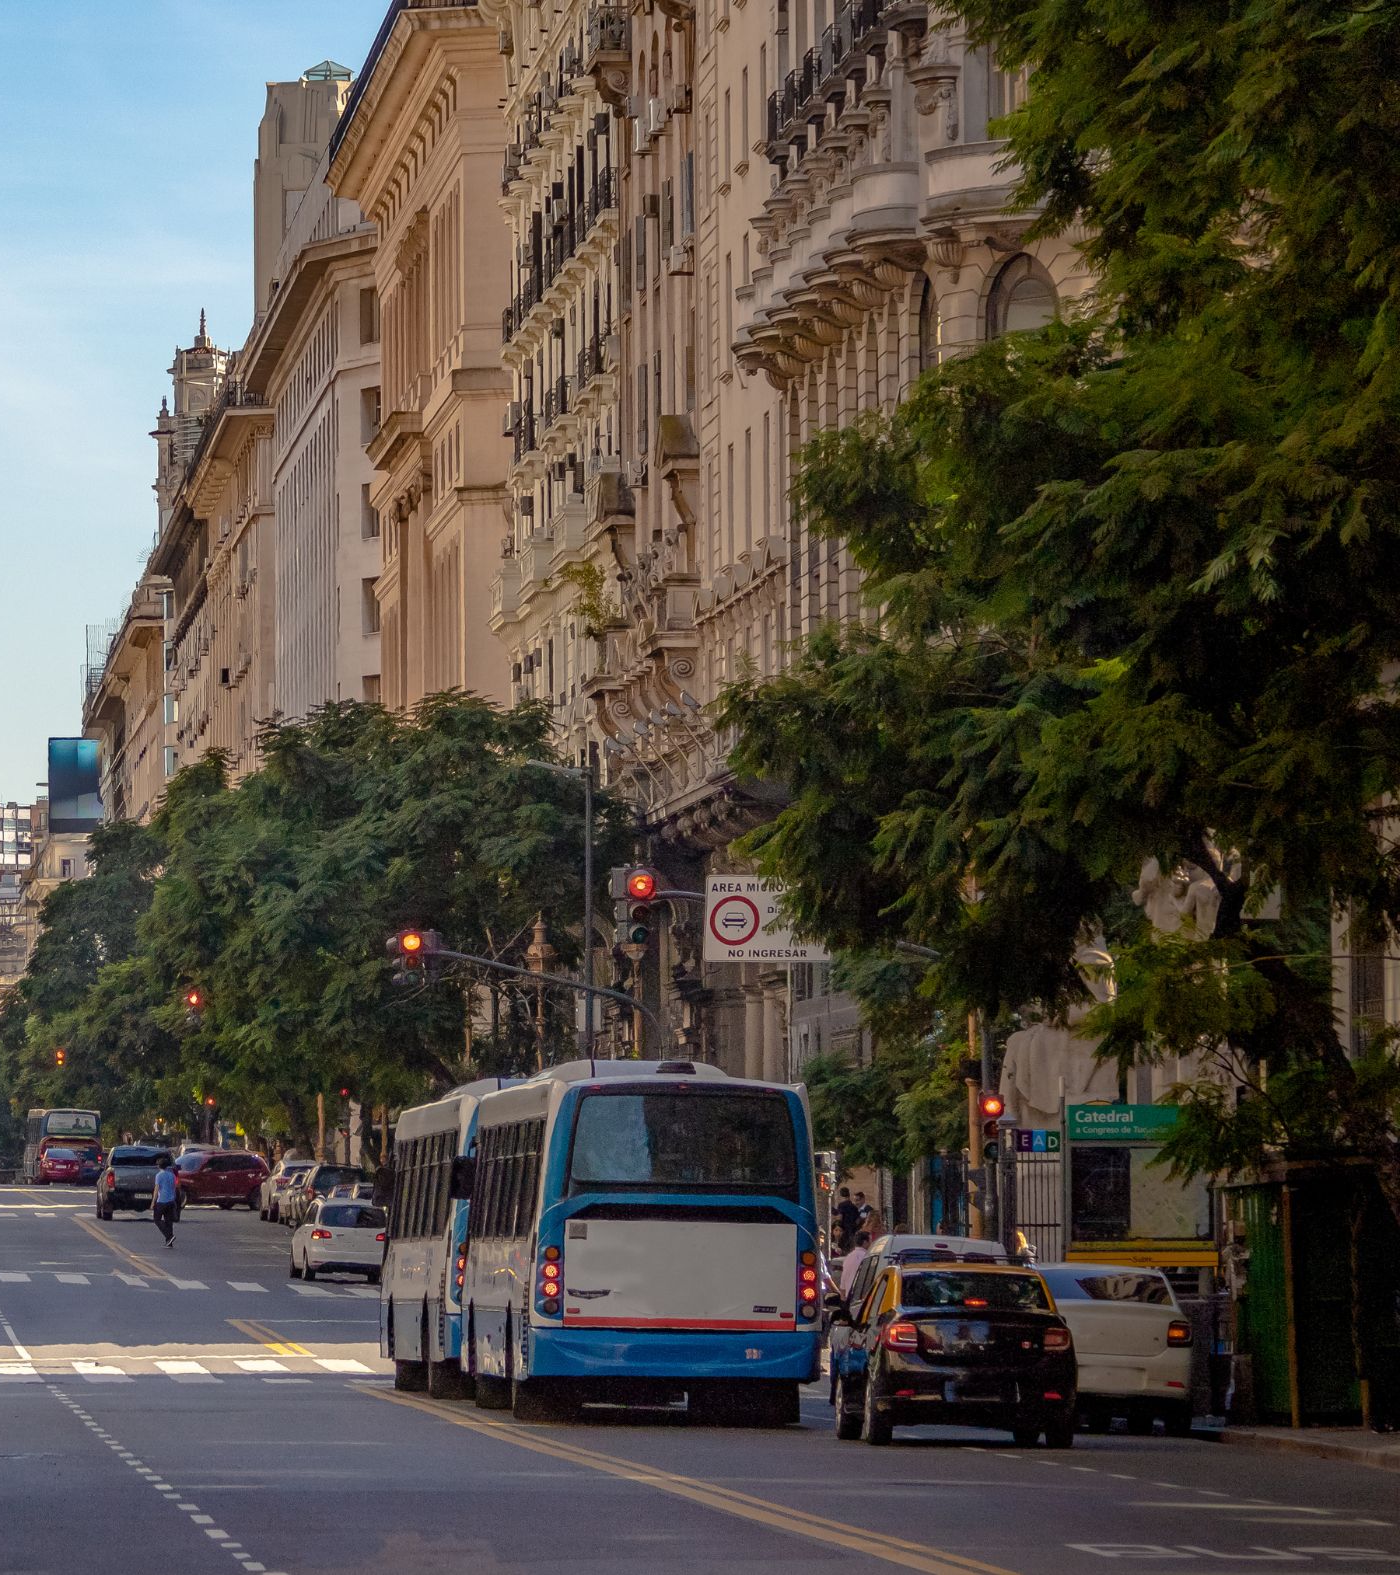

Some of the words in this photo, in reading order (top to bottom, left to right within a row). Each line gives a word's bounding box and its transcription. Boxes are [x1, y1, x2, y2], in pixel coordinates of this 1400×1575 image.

[711, 883, 742, 893] AREA
[727, 949, 744, 958] NO
[748, 949, 808, 958] INGRESAR
[1075, 1109, 1134, 1123] Catedral
[1082, 1126, 1119, 1136] Congreso
[1120, 1126, 1131, 1134] de
